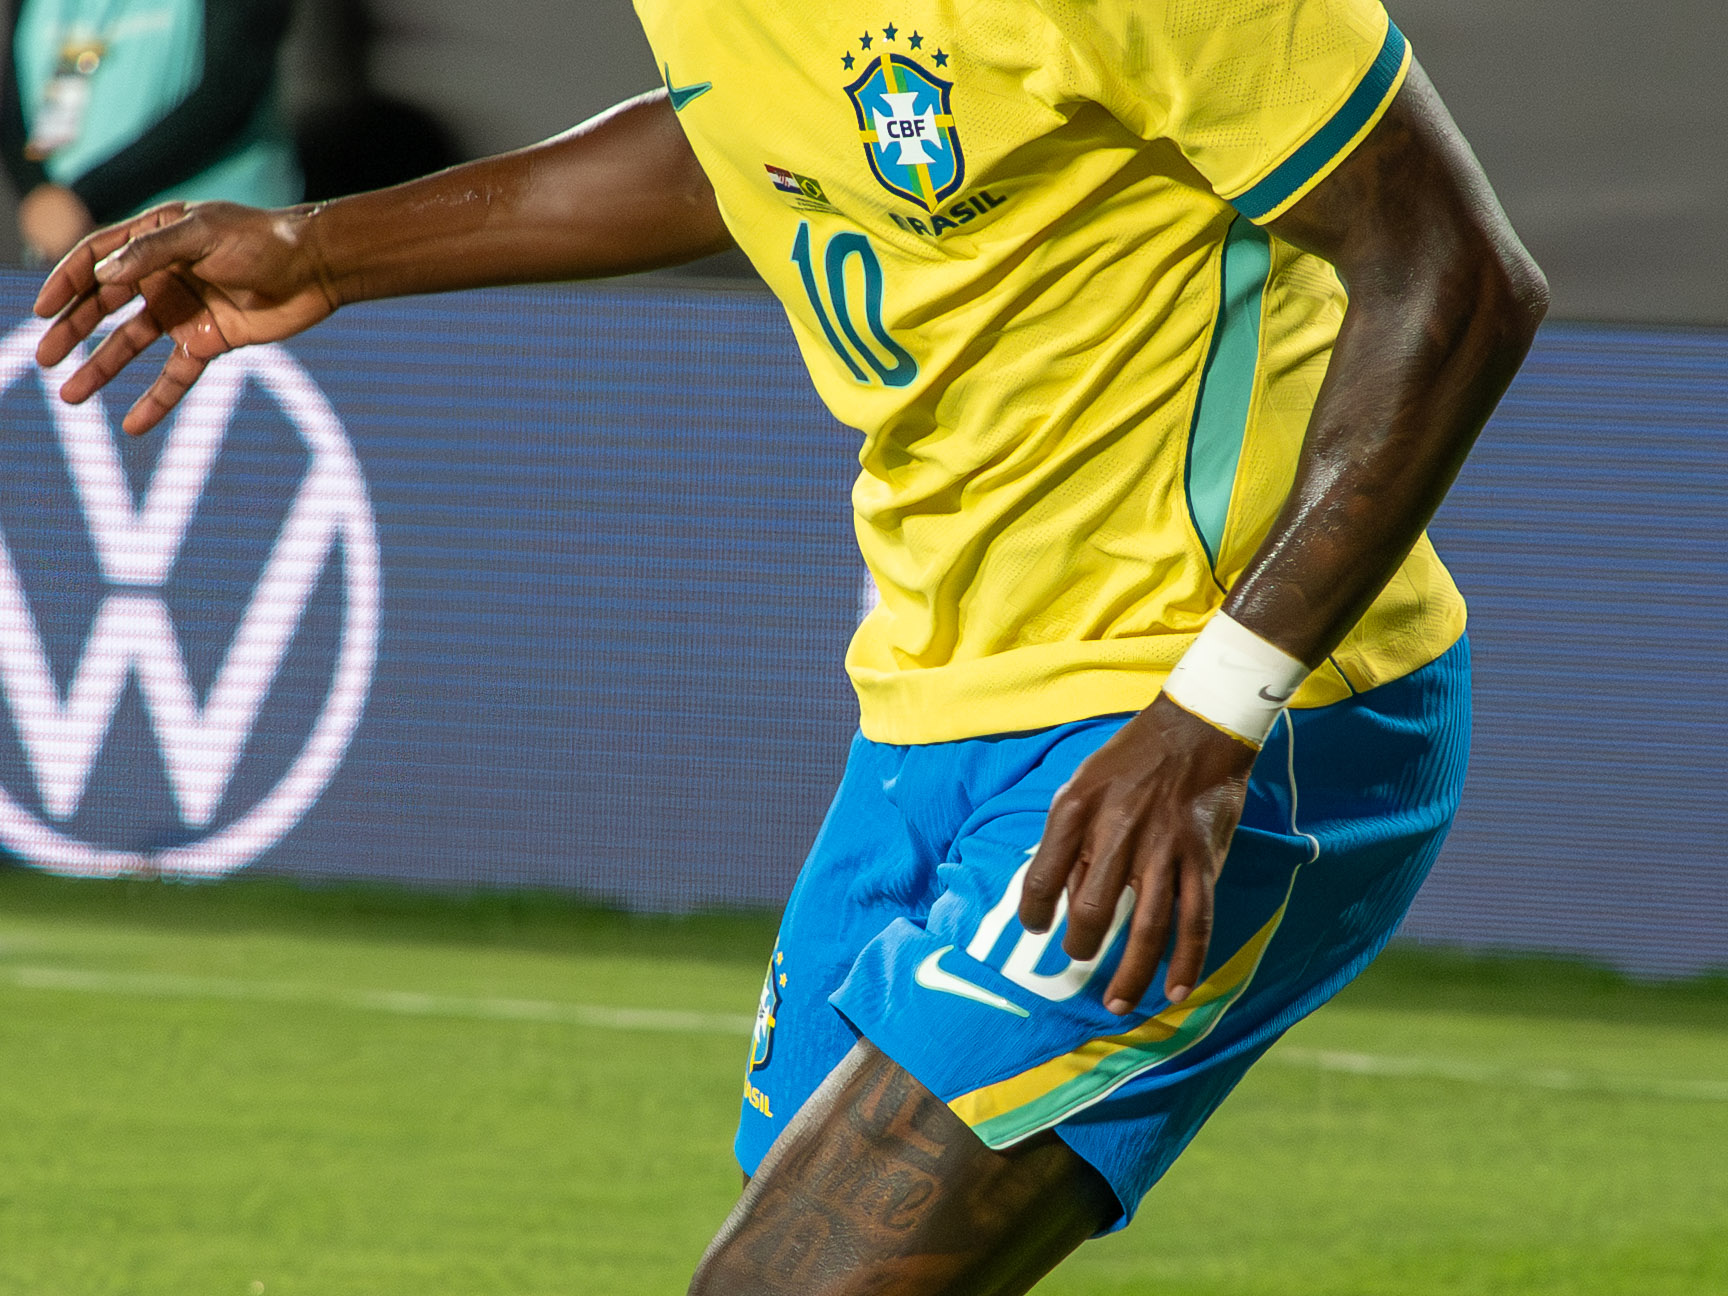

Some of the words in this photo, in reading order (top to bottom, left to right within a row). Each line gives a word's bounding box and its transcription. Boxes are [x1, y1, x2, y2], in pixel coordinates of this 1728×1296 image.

[886, 119, 926, 139] CBF
[791, 220, 919, 387] 10
[744, 1080, 774, 1118] ASIL
